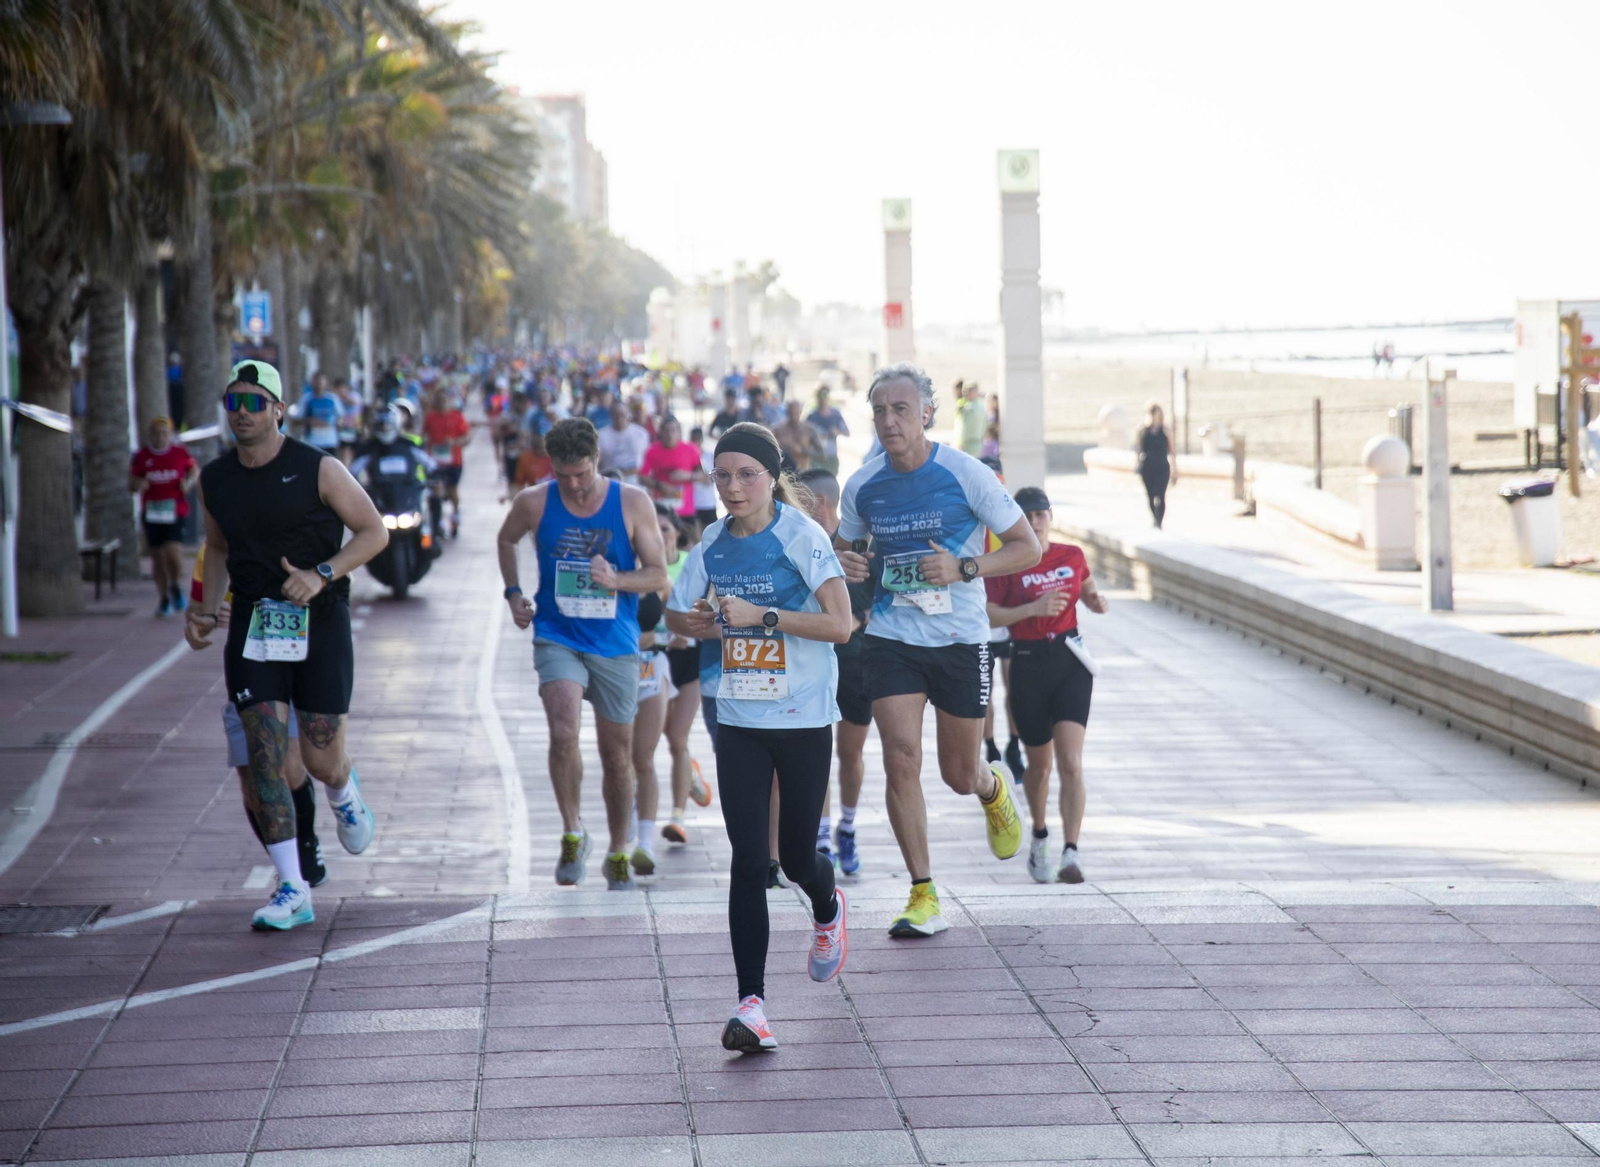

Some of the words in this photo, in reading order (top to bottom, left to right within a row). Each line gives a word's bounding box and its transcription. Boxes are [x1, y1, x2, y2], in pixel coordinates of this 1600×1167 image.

[870, 515, 897, 524] Medio
[900, 510, 943, 522] Maratón
[871, 522, 909, 534] Almería
[911, 518, 942, 531] 2025
[710, 573, 732, 583] Medio
[714, 584, 744, 596] lmería
[745, 581, 774, 595] 2025
[725, 638, 780, 662] 1872
